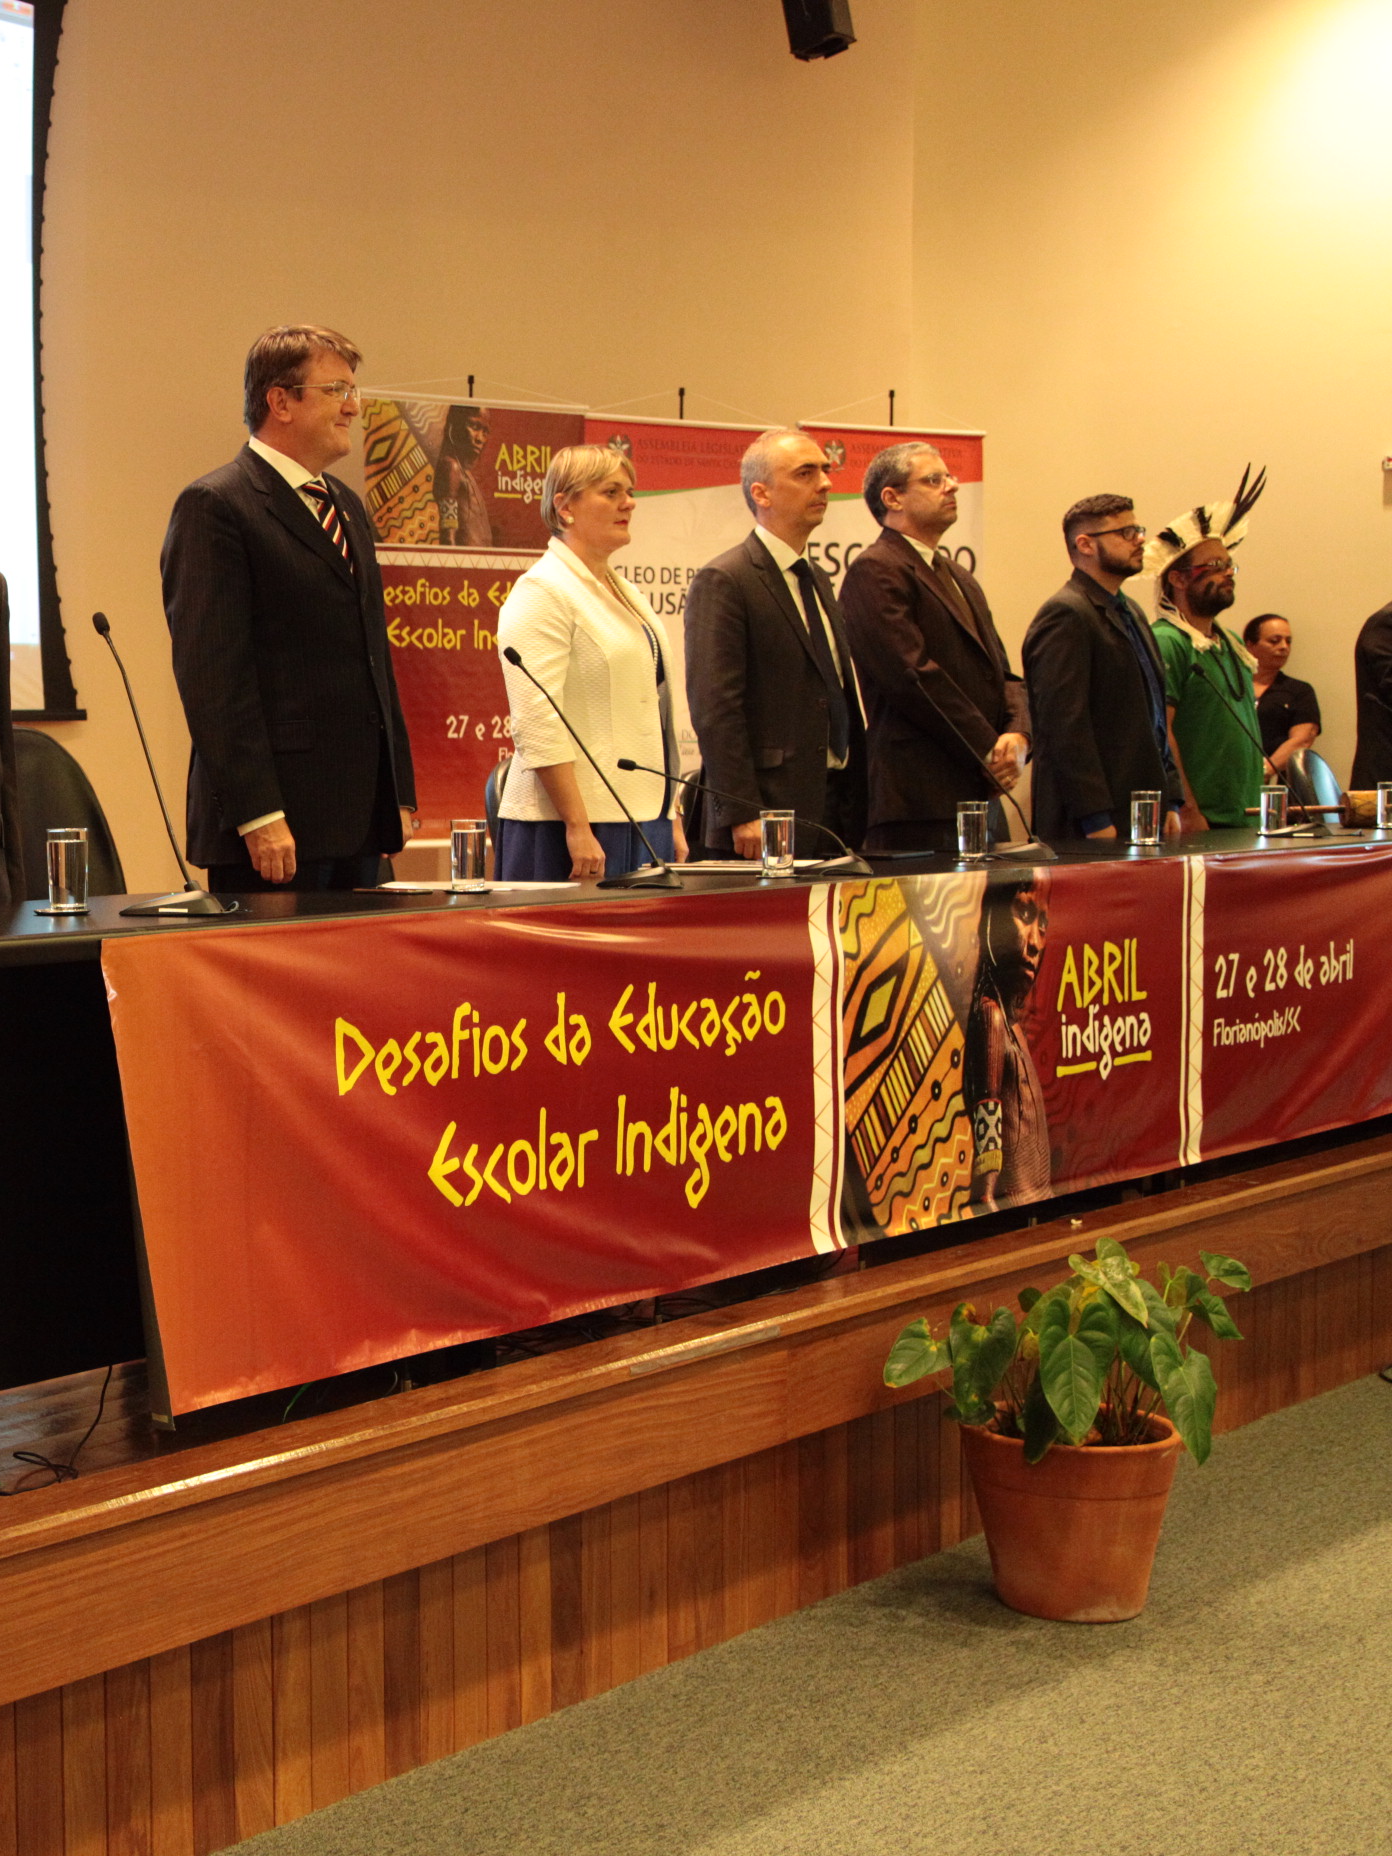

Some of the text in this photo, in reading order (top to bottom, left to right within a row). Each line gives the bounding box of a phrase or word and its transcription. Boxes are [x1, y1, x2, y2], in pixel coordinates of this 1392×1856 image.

[383, 578, 450, 606] esafios
[458, 580, 479, 608] da
[660, 567, 682, 585] DE
[387, 617, 466, 650] Escolar
[446, 714, 512, 741] 27 e 28
[1057, 937, 1148, 1013] ABRIL
[1214, 938, 1354, 999] 27 e 28 de abril
[334, 969, 786, 1097] Desafios da Educação
[1213, 1005, 1302, 1049] Florianópolis/SC
[427, 1107, 599, 1207] Escolar
